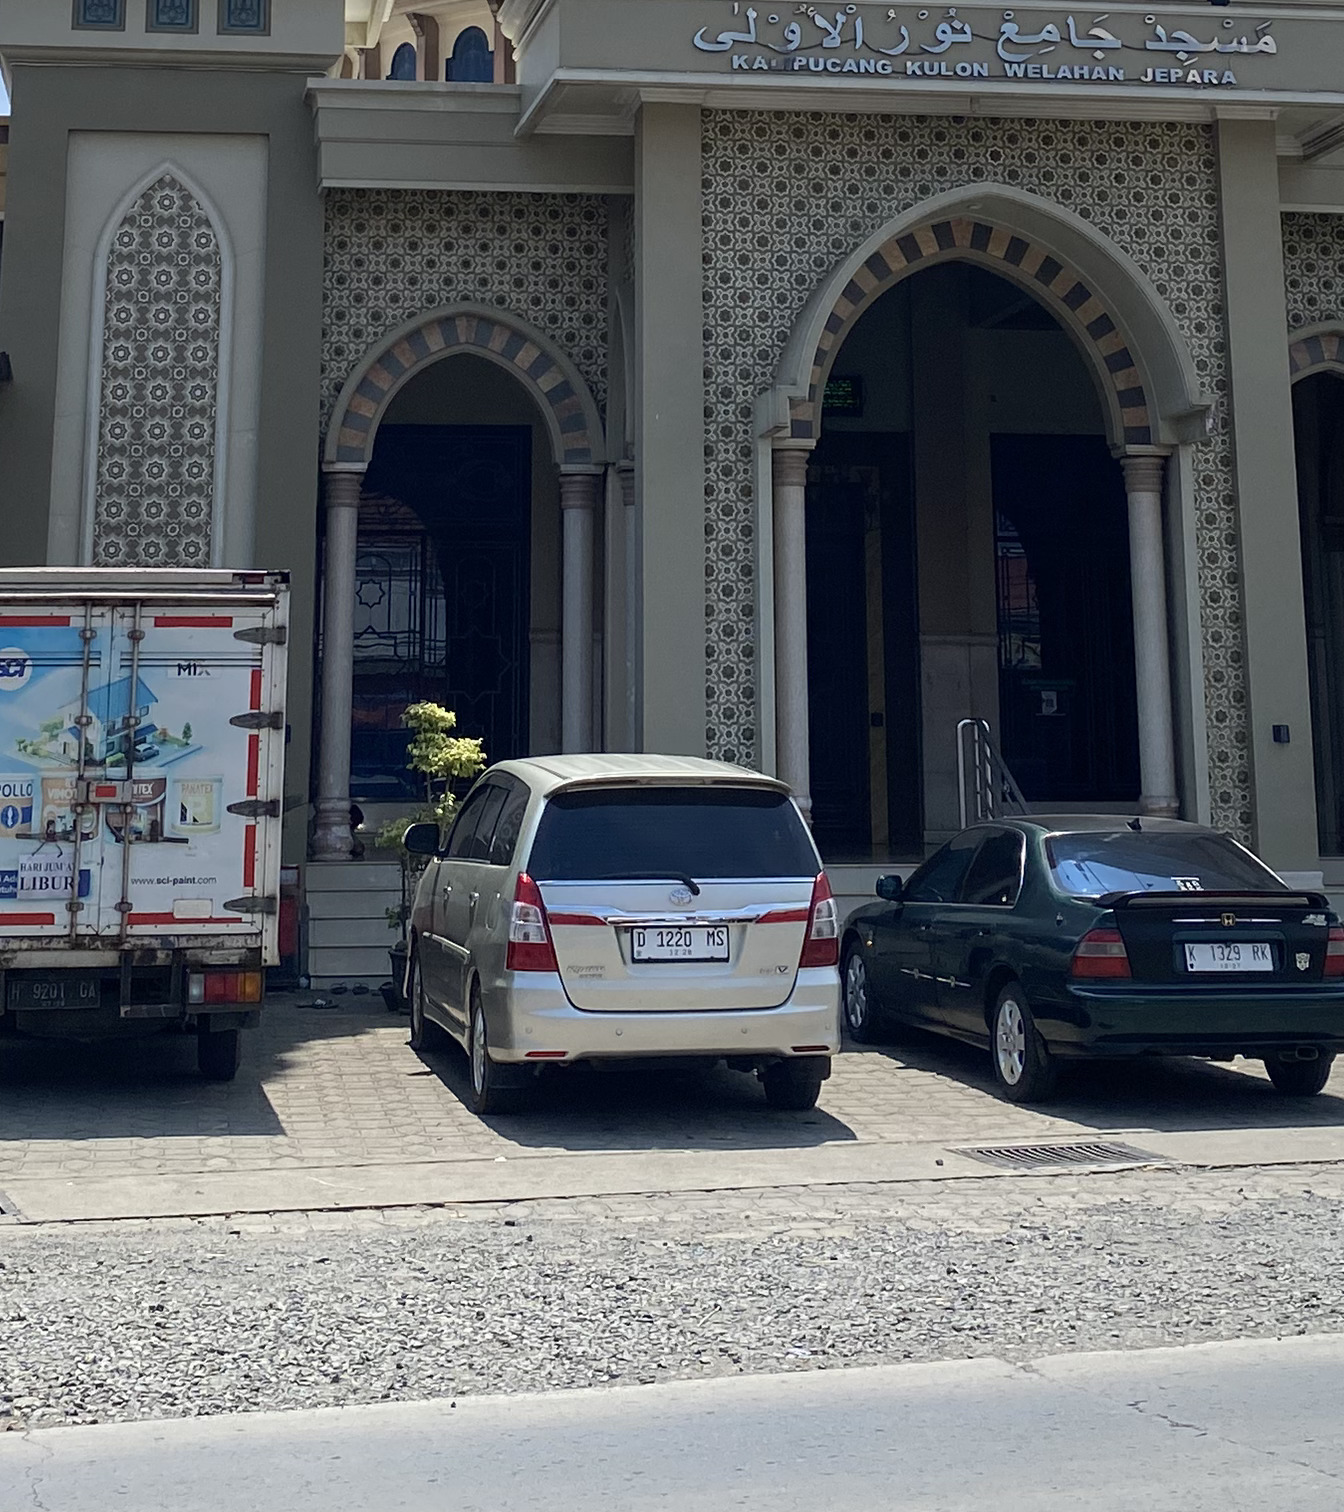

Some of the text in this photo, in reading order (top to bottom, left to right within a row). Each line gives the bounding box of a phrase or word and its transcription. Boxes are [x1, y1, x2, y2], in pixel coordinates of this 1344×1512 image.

[905, 60, 989, 77] KULON
[1004, 63, 1125, 81] WELAHAN
[1140, 67, 1237, 85] JEPARA
[20, 862, 43, 872] HARI
[19, 876, 75, 891] LIBUR
[130, 876, 217, 886] www.sci-paint.com
[637, 930, 725, 948] D 1220 MS
[1187, 945, 1270, 962] K 1329 RK
[33, 982, 65, 1000] 9201
